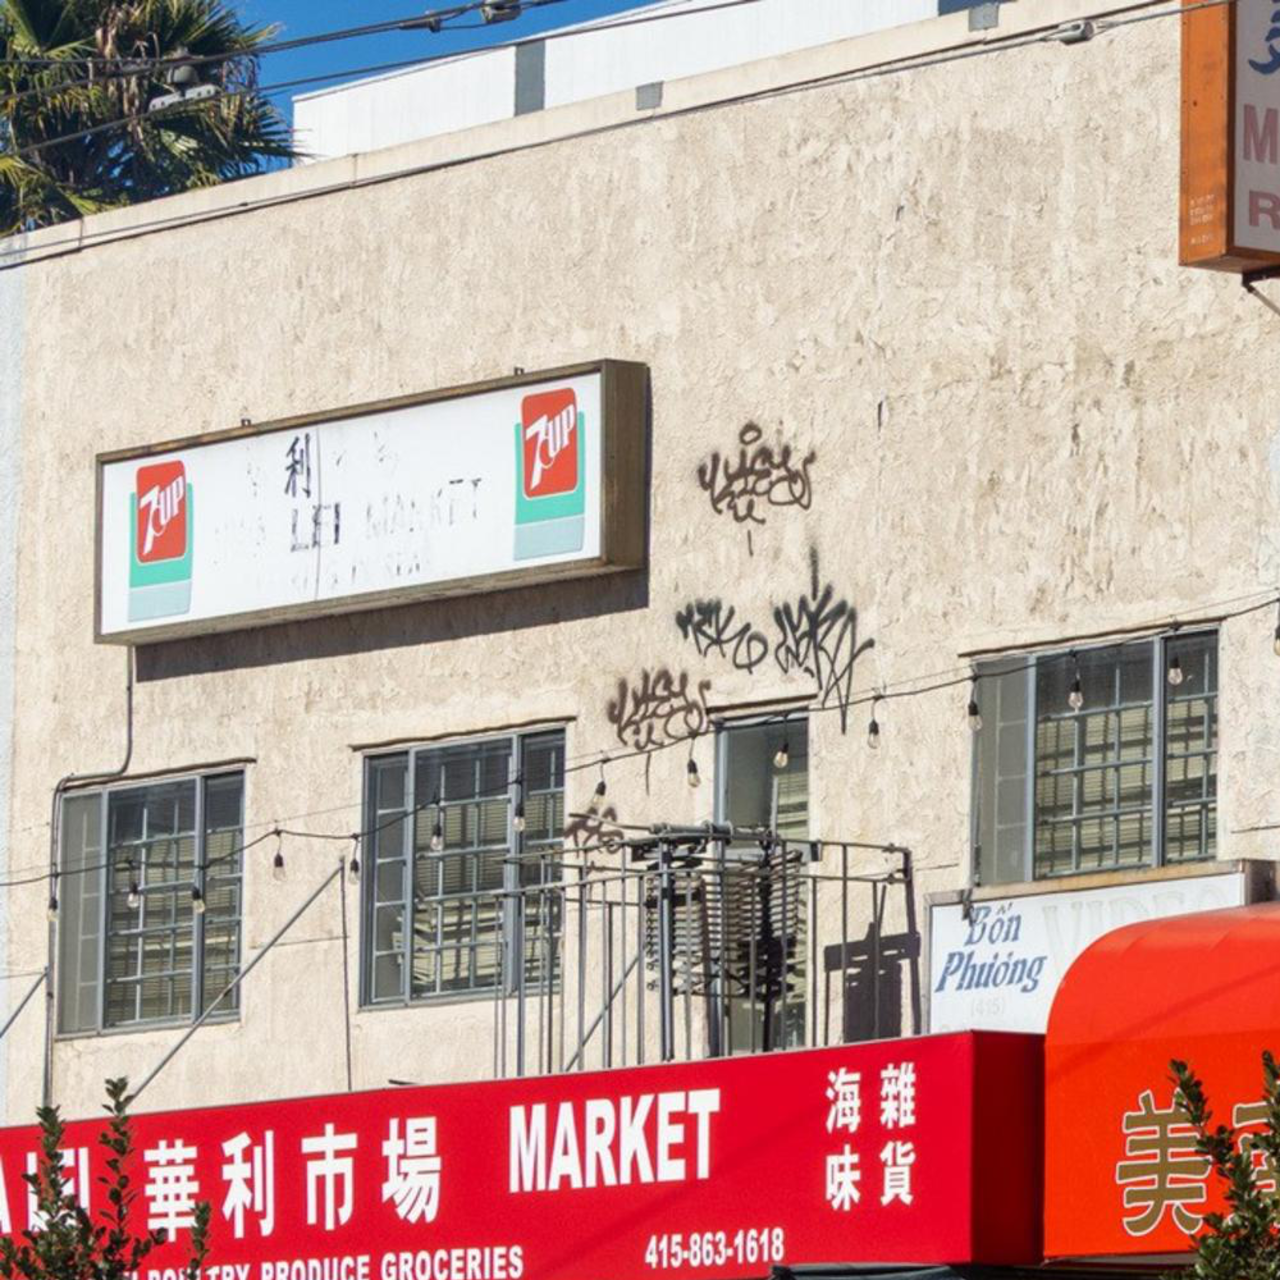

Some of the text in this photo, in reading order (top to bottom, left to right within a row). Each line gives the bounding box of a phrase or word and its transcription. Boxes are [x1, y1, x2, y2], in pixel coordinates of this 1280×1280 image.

[144, 1116, 442, 1243] 華利市場
[508, 1088, 721, 1194] MARKET
[825, 1066, 862, 1212] 海味
[645, 1228, 785, 1269] 415-863-1618
